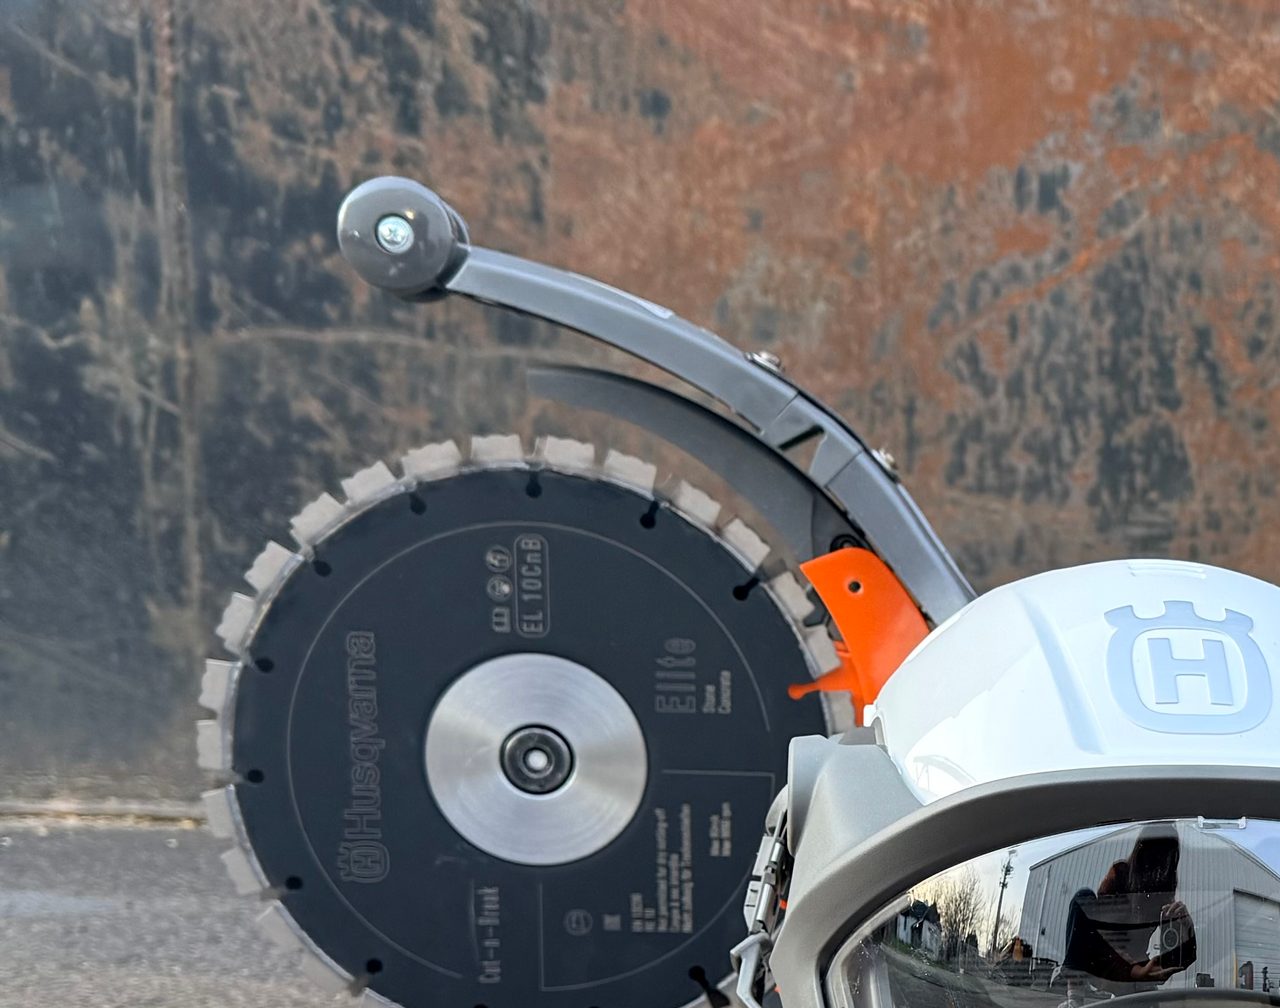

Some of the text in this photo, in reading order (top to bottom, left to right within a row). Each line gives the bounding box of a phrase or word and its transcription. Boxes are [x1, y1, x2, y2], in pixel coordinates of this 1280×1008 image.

[522, 609, 544, 633] EL
[655, 637, 697, 714] Elite
[346, 630, 387, 840] Husqvarna
